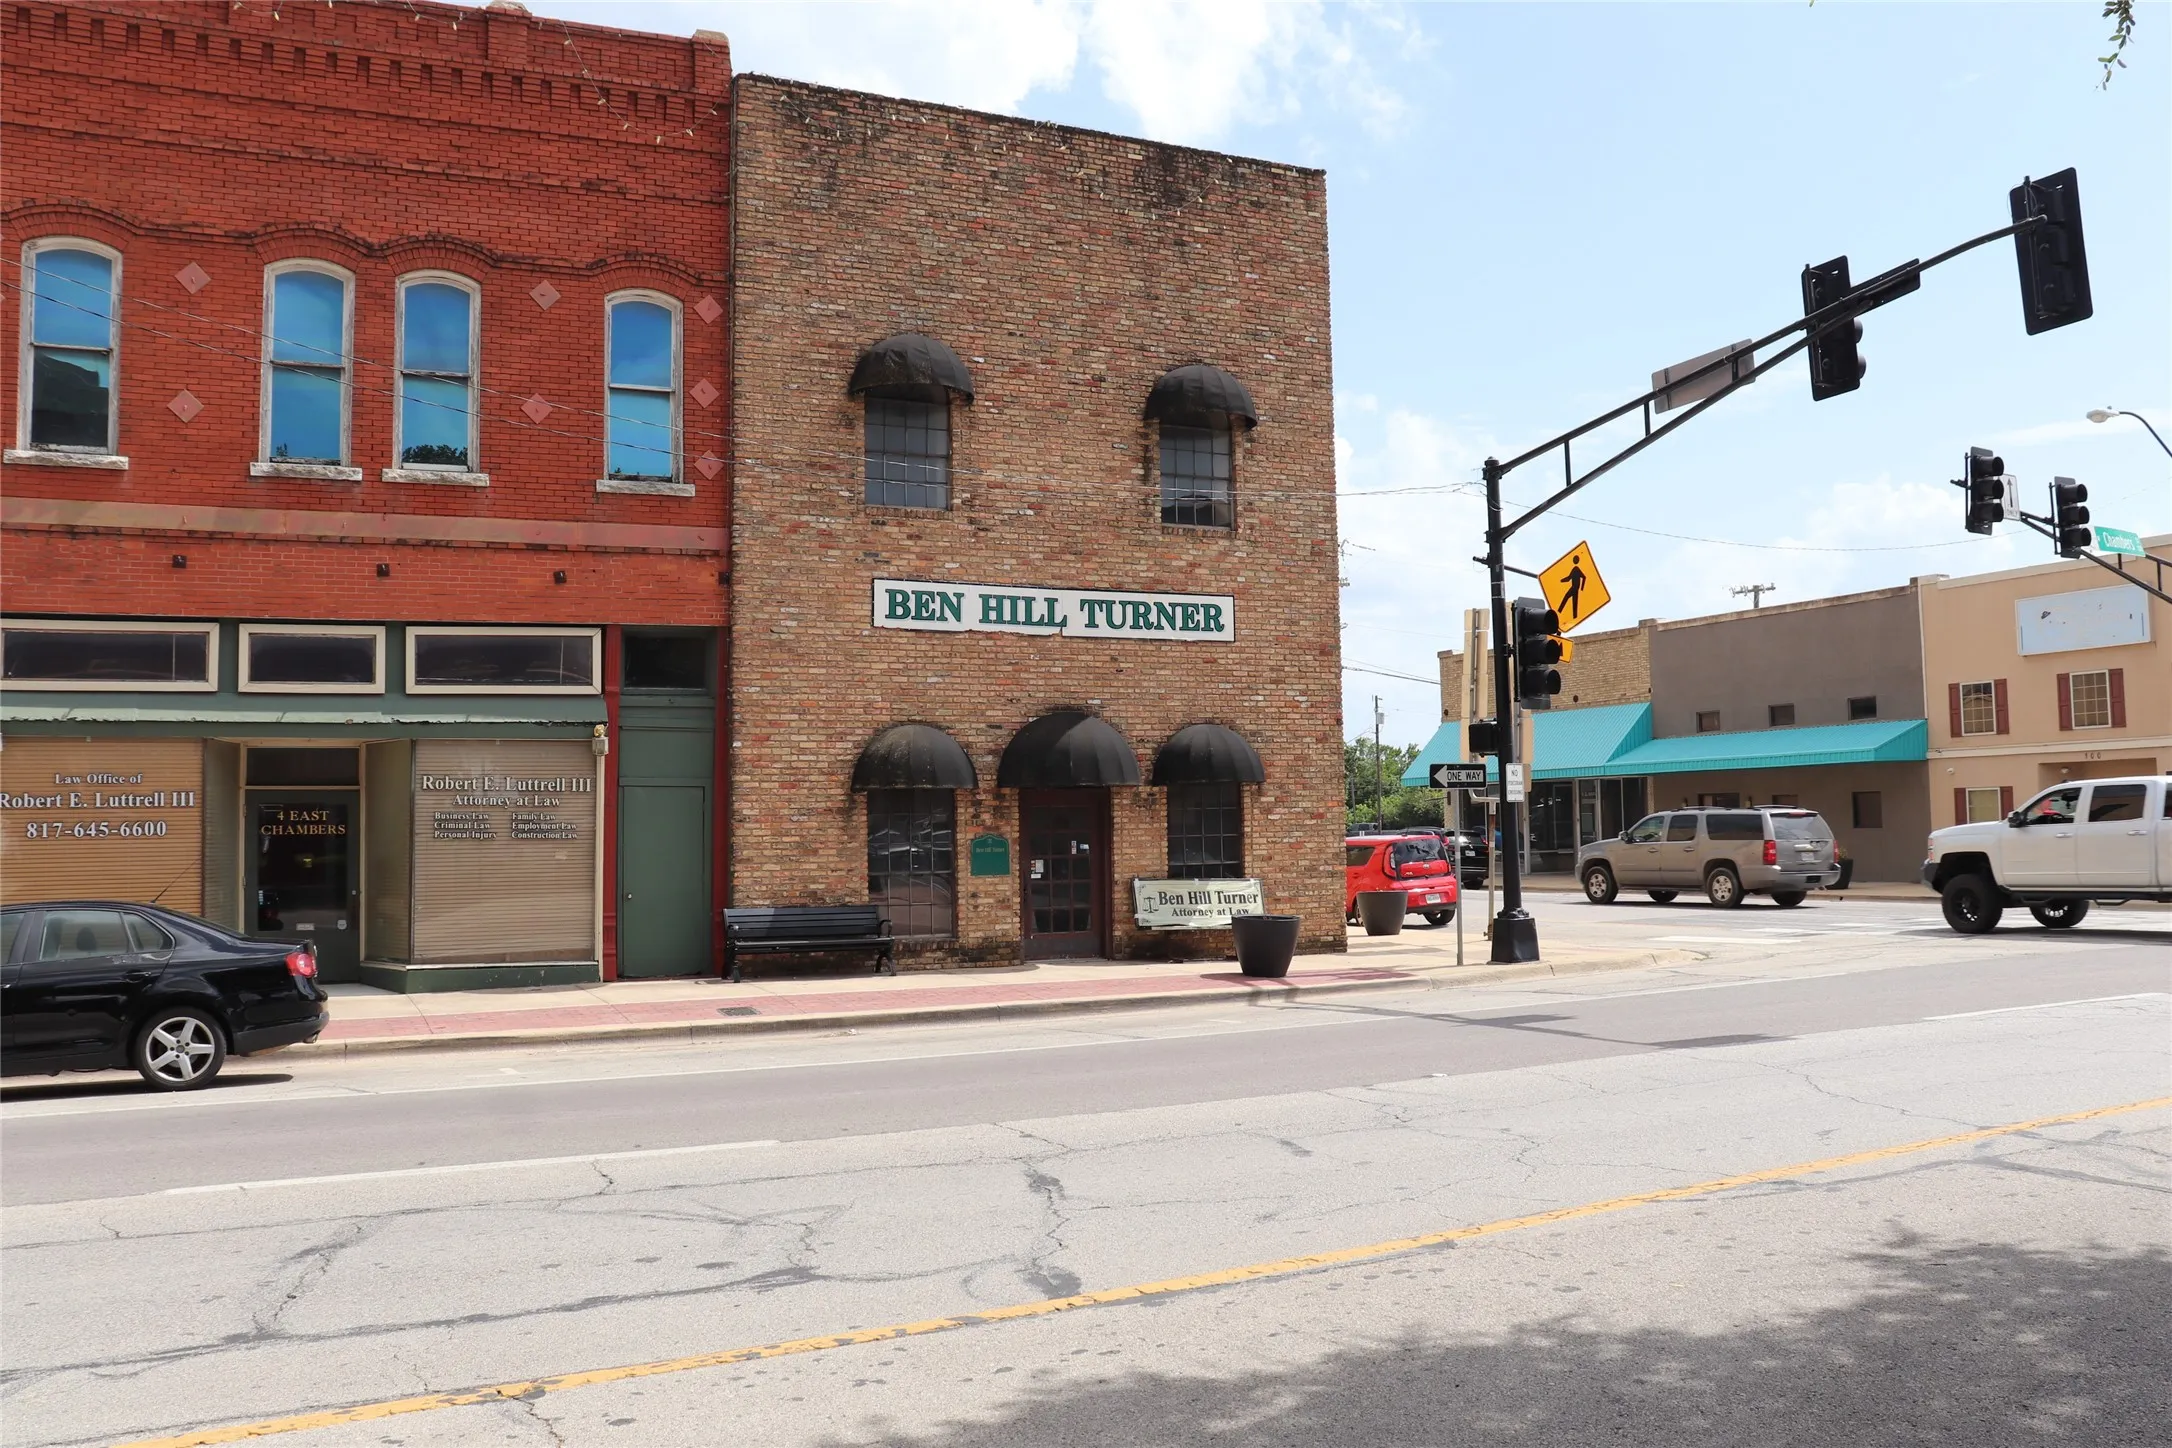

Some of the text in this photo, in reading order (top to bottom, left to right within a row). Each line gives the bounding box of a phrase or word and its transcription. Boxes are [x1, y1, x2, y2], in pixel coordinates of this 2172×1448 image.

[2102, 531, 2136, 551] Chambers
[884, 588, 1225, 633] BEN HILL TURNER
[55, 773, 143, 784] Law Office of
[1446, 771, 1481, 781] ONE WAY
[422, 775, 592, 792] Robert E. Luttrell III
[0, 791, 195, 808] Robert E. Luttrell III
[453, 794, 561, 809] Attorney at Law
[277, 810, 330, 821] 4 EAST
[434, 812, 489, 820] Business Law
[512, 813, 556, 822] Family Law
[26, 820, 168, 838] 817-645-6600
[260, 824, 346, 835] CHAMBERS
[512, 822, 559, 831] Employment
[434, 831, 497, 840] Personal Injury
[511, 831, 578, 839] Construction Law
[1158, 890, 1259, 906] Ben Hill Turner
[1171, 907, 1249, 918] Attorney at Law
